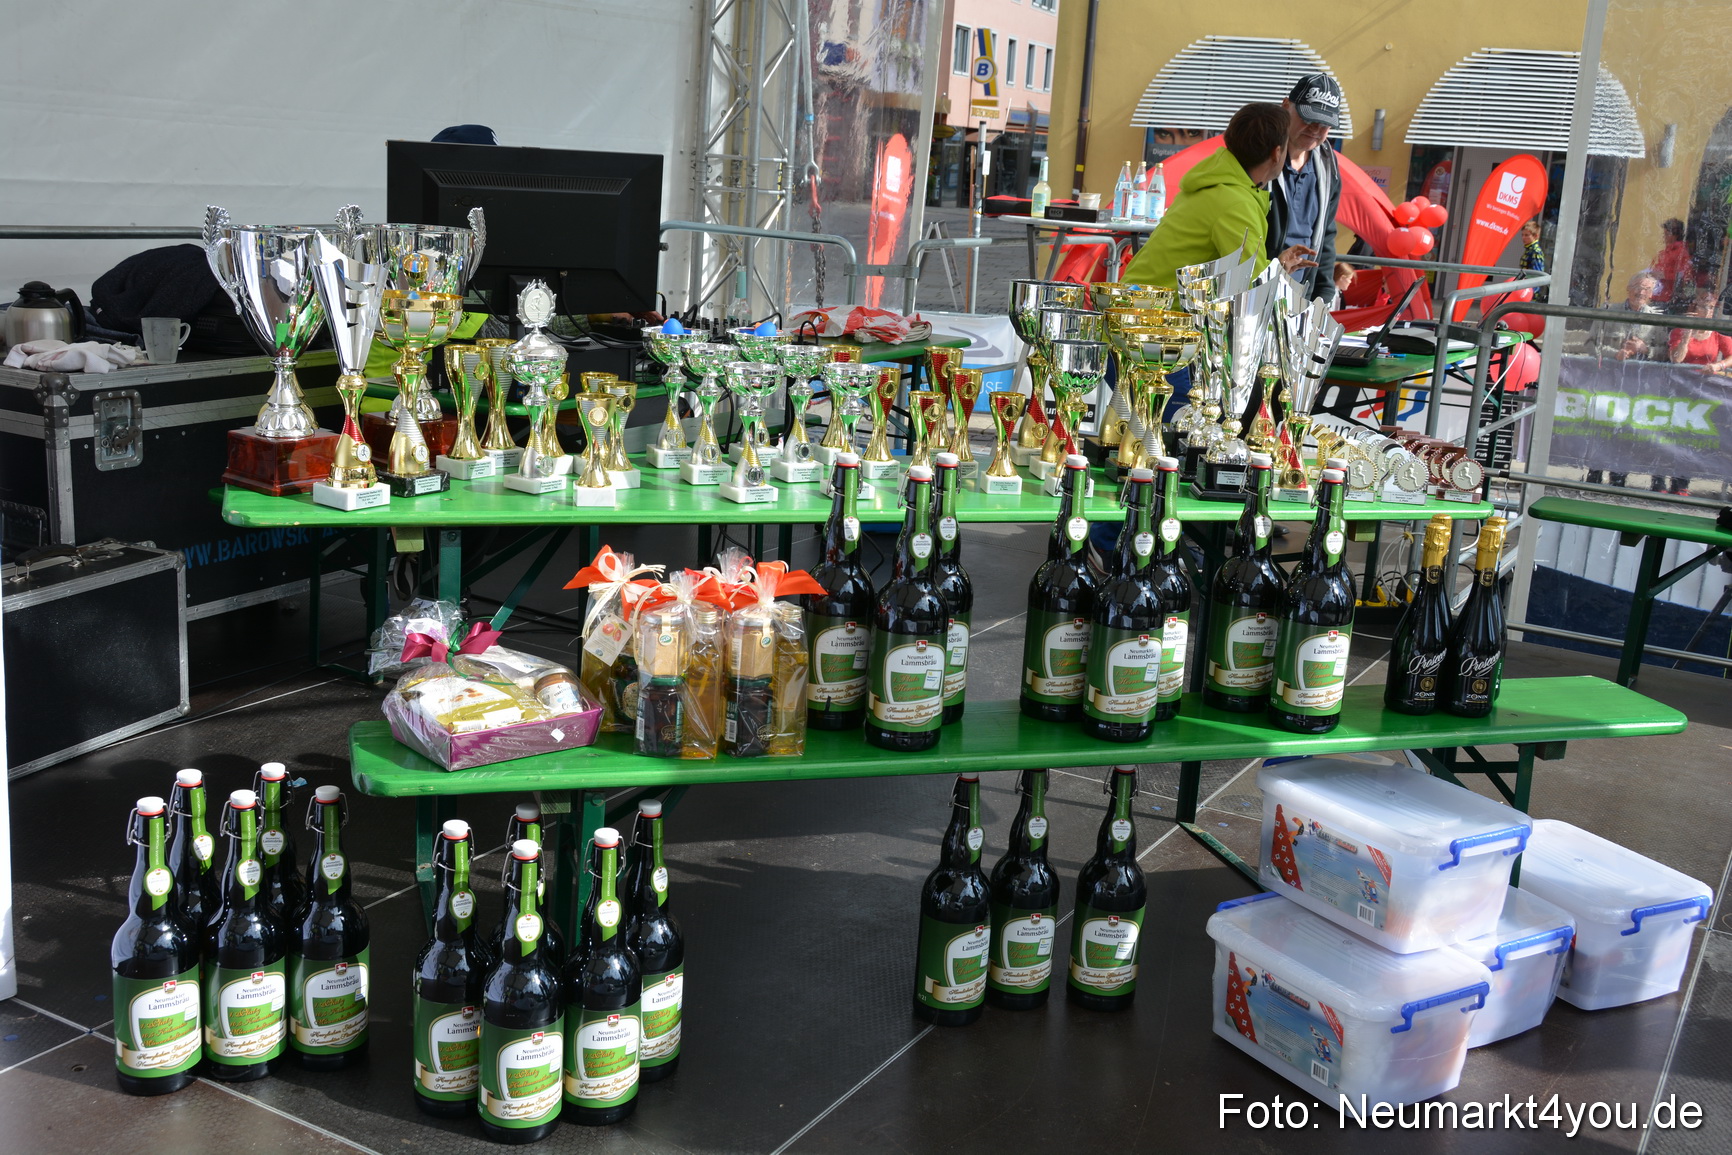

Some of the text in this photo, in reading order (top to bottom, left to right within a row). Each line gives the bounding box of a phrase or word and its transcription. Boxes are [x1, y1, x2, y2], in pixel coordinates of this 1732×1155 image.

[976, 63, 989, 76] B
[1306, 87, 1340, 106] Dubai
[1499, 192, 1518, 205] DKMS
[321, 979, 360, 990] Lammsbräu
[327, 975, 355, 984] Neumarkter
[236, 988, 276, 1000] Lammsbräu
[242, 984, 272, 993] Neumarkter
[149, 997, 189, 1010] Lammsbräu
[155, 993, 185, 1003] Neumarkter
[592, 1032, 630, 1041] Lammsbräu
[516, 1049, 555, 1061] Lammsbräu
[523, 1045, 551, 1054] Neumarkter
